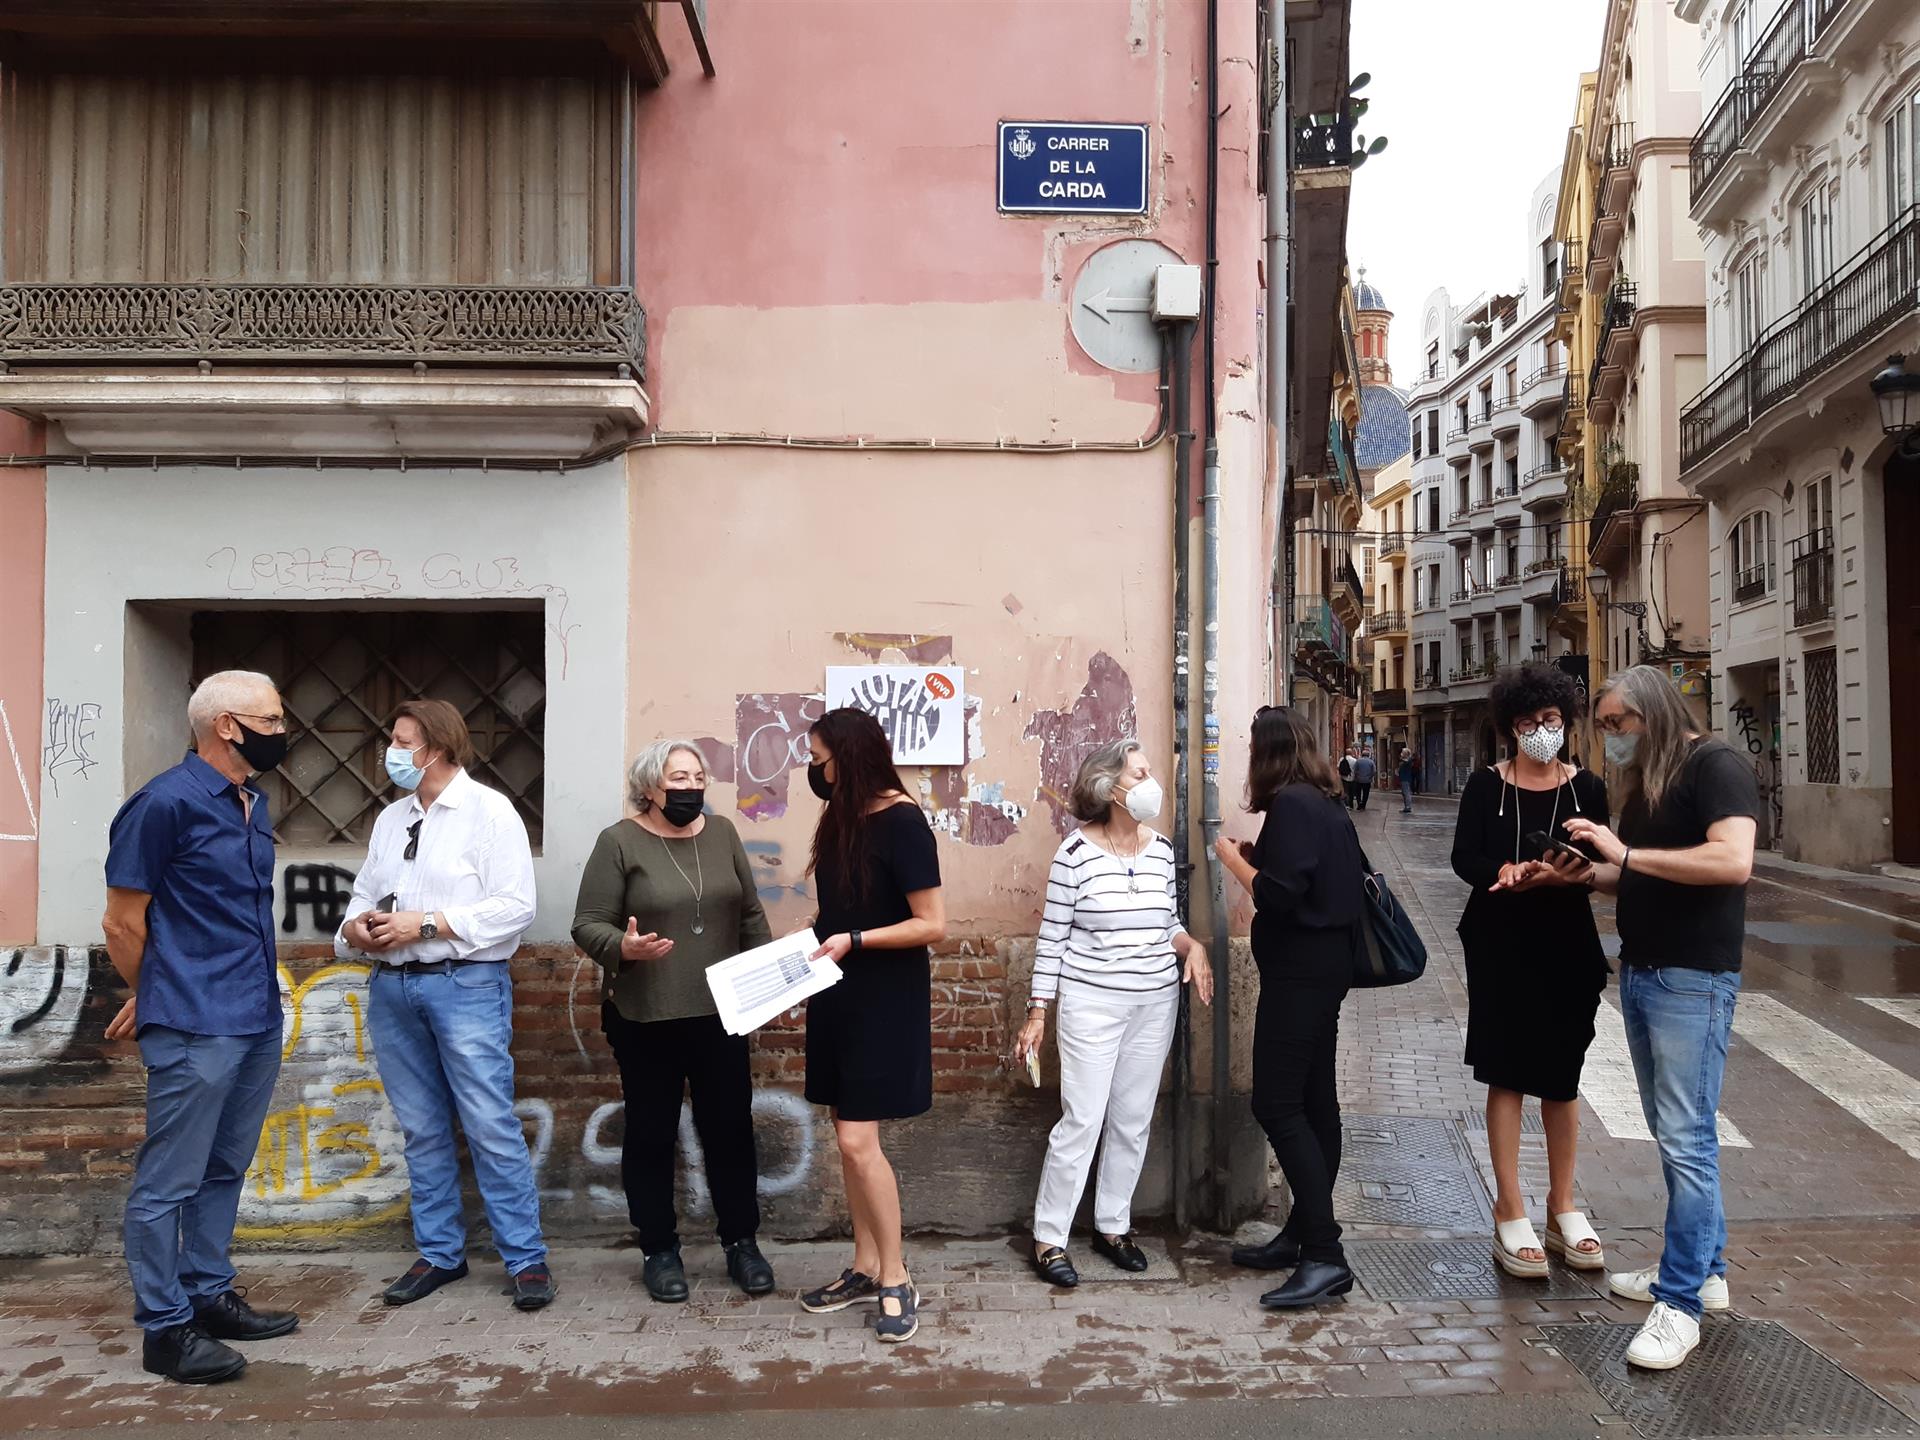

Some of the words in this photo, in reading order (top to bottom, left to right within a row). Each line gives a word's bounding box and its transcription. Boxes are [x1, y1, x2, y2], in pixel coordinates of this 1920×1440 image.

[1047, 137, 1109, 150] CARRER
[1050, 161, 1070, 173] DE
[1075, 161, 1096, 173] LA
[1039, 181, 1106, 198] CARDA
[932, 678, 950, 697] VIVA
